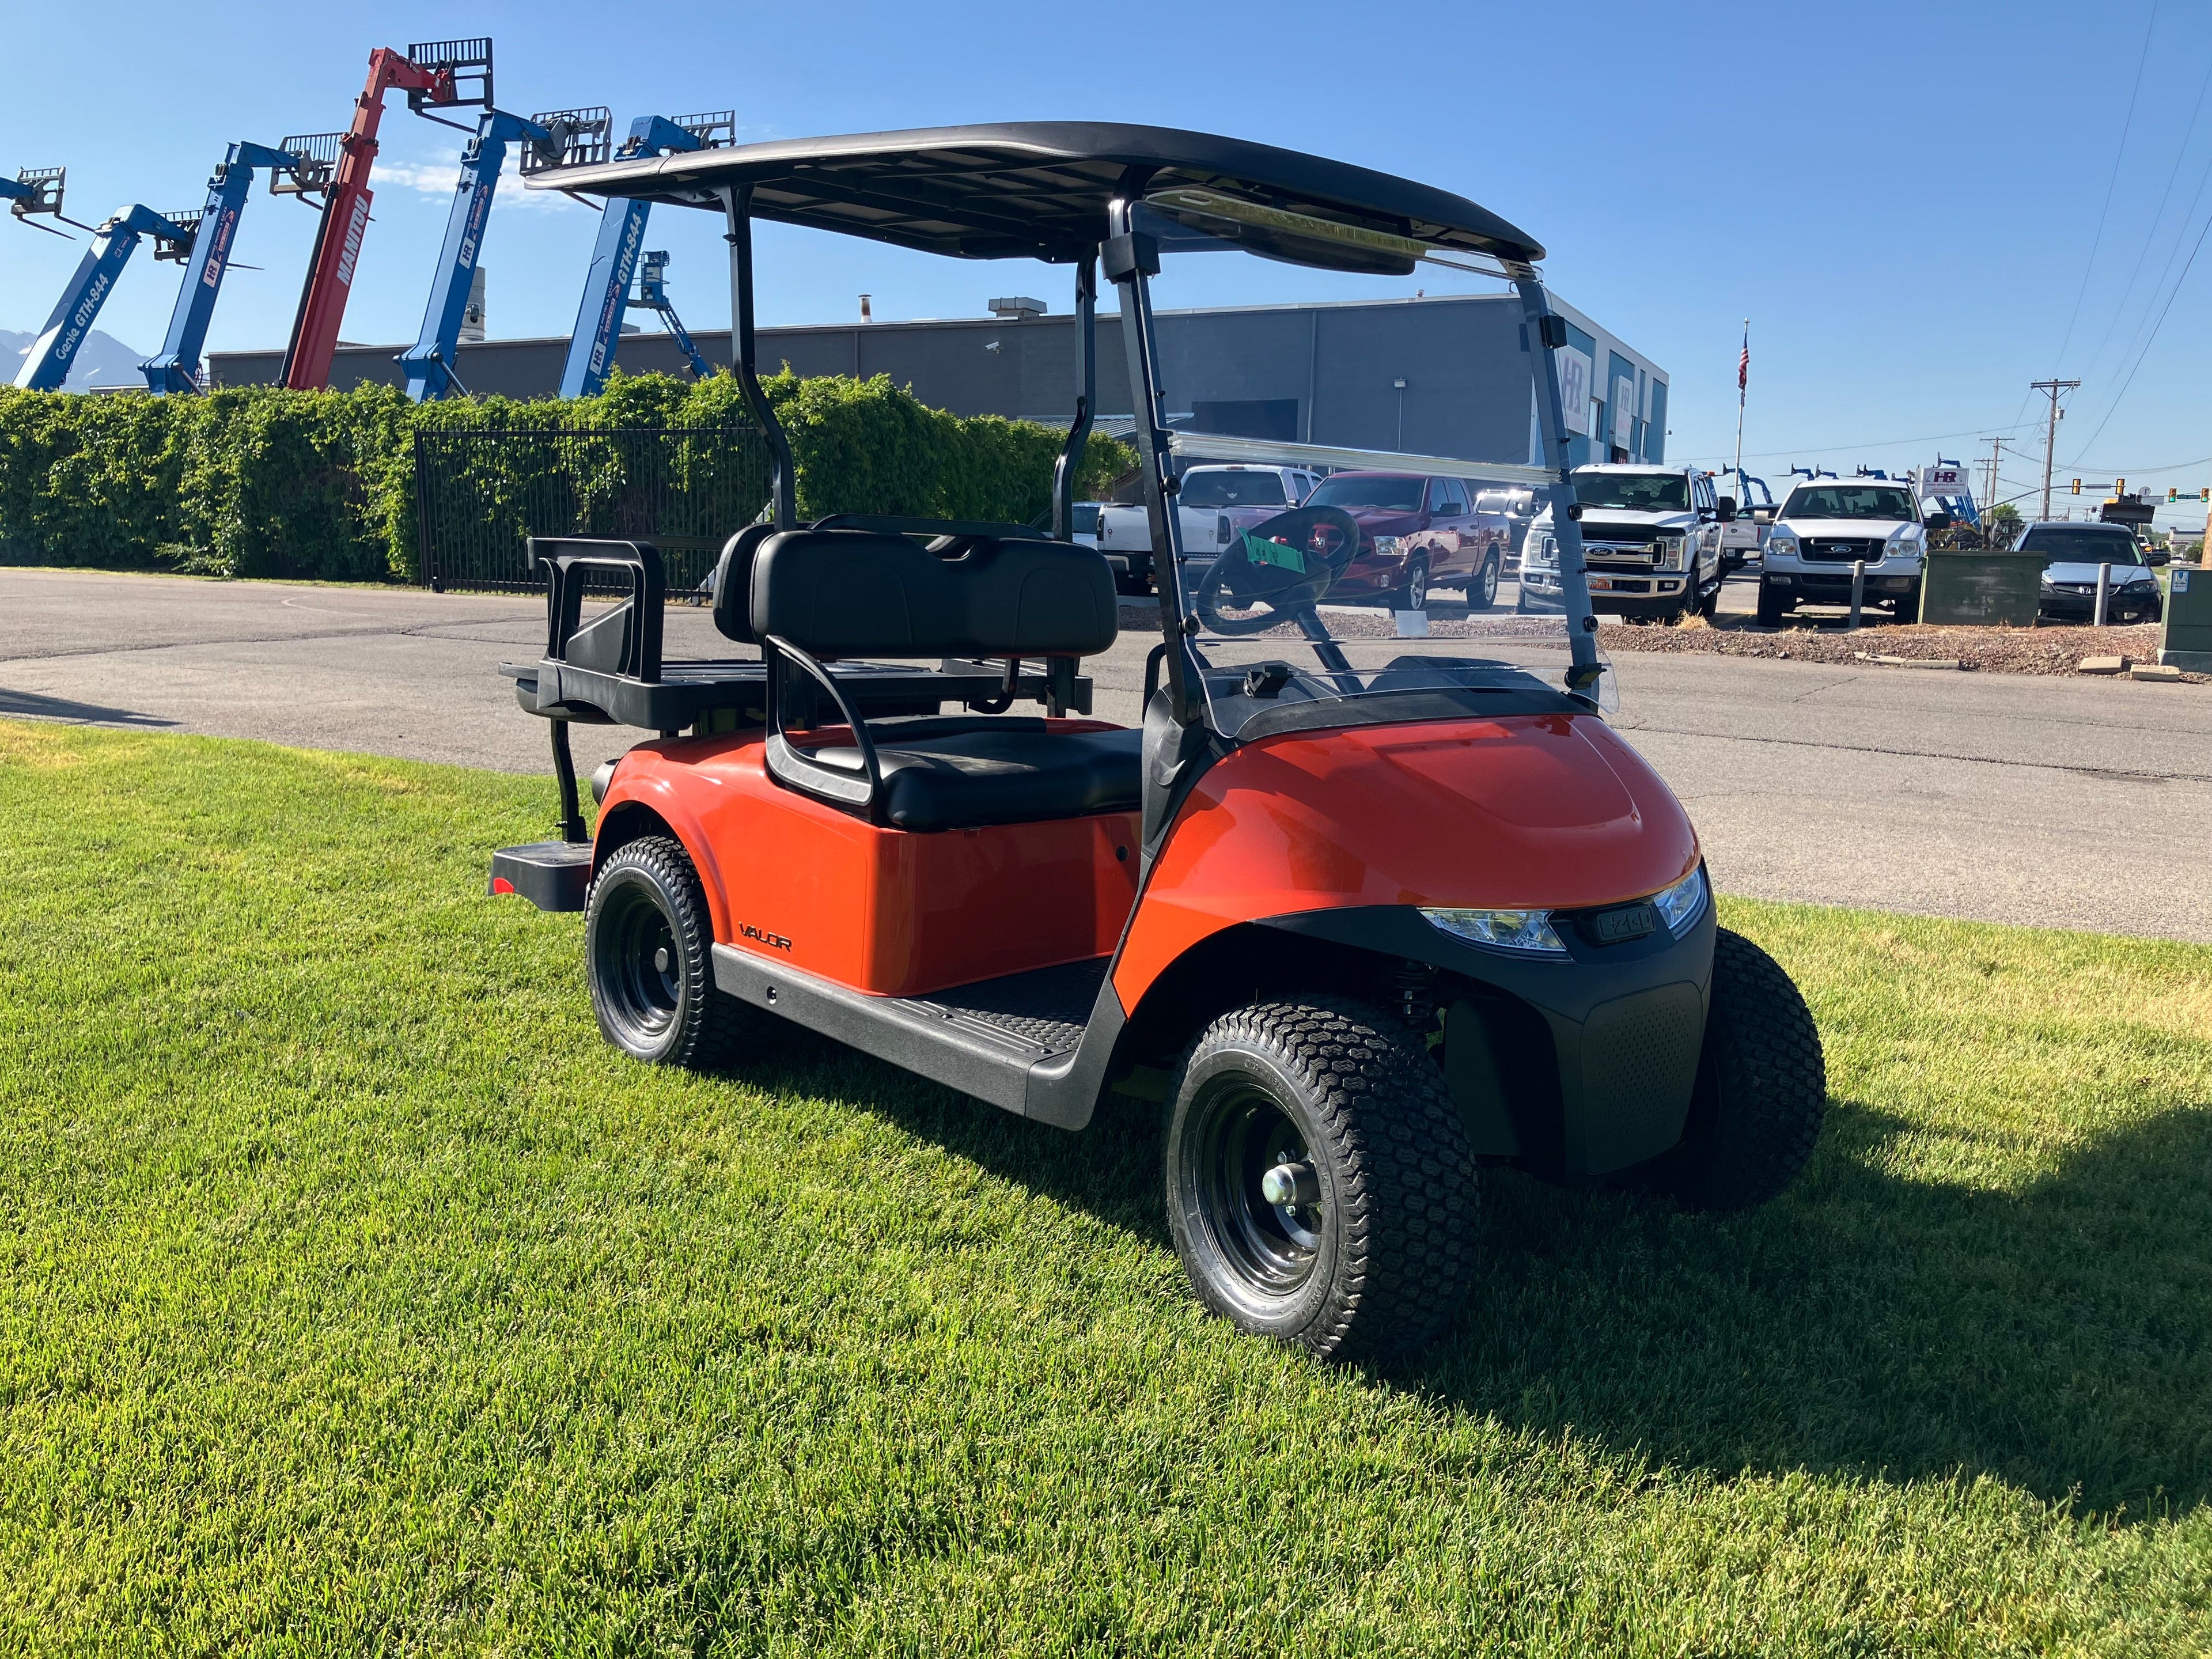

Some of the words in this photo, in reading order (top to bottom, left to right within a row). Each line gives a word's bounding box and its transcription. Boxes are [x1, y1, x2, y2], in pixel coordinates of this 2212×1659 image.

[336, 194, 368, 286] MANITOU
[618, 213, 642, 285] GTH-844
[463, 244, 472, 262] HR
[207, 264, 217, 281] HR
[55, 328, 80, 359] Genie
[75, 272, 109, 327] GTH-844
[593, 349, 603, 367] HR
[1934, 471, 1957, 482] HR
[738, 921, 792, 953] VALOR
